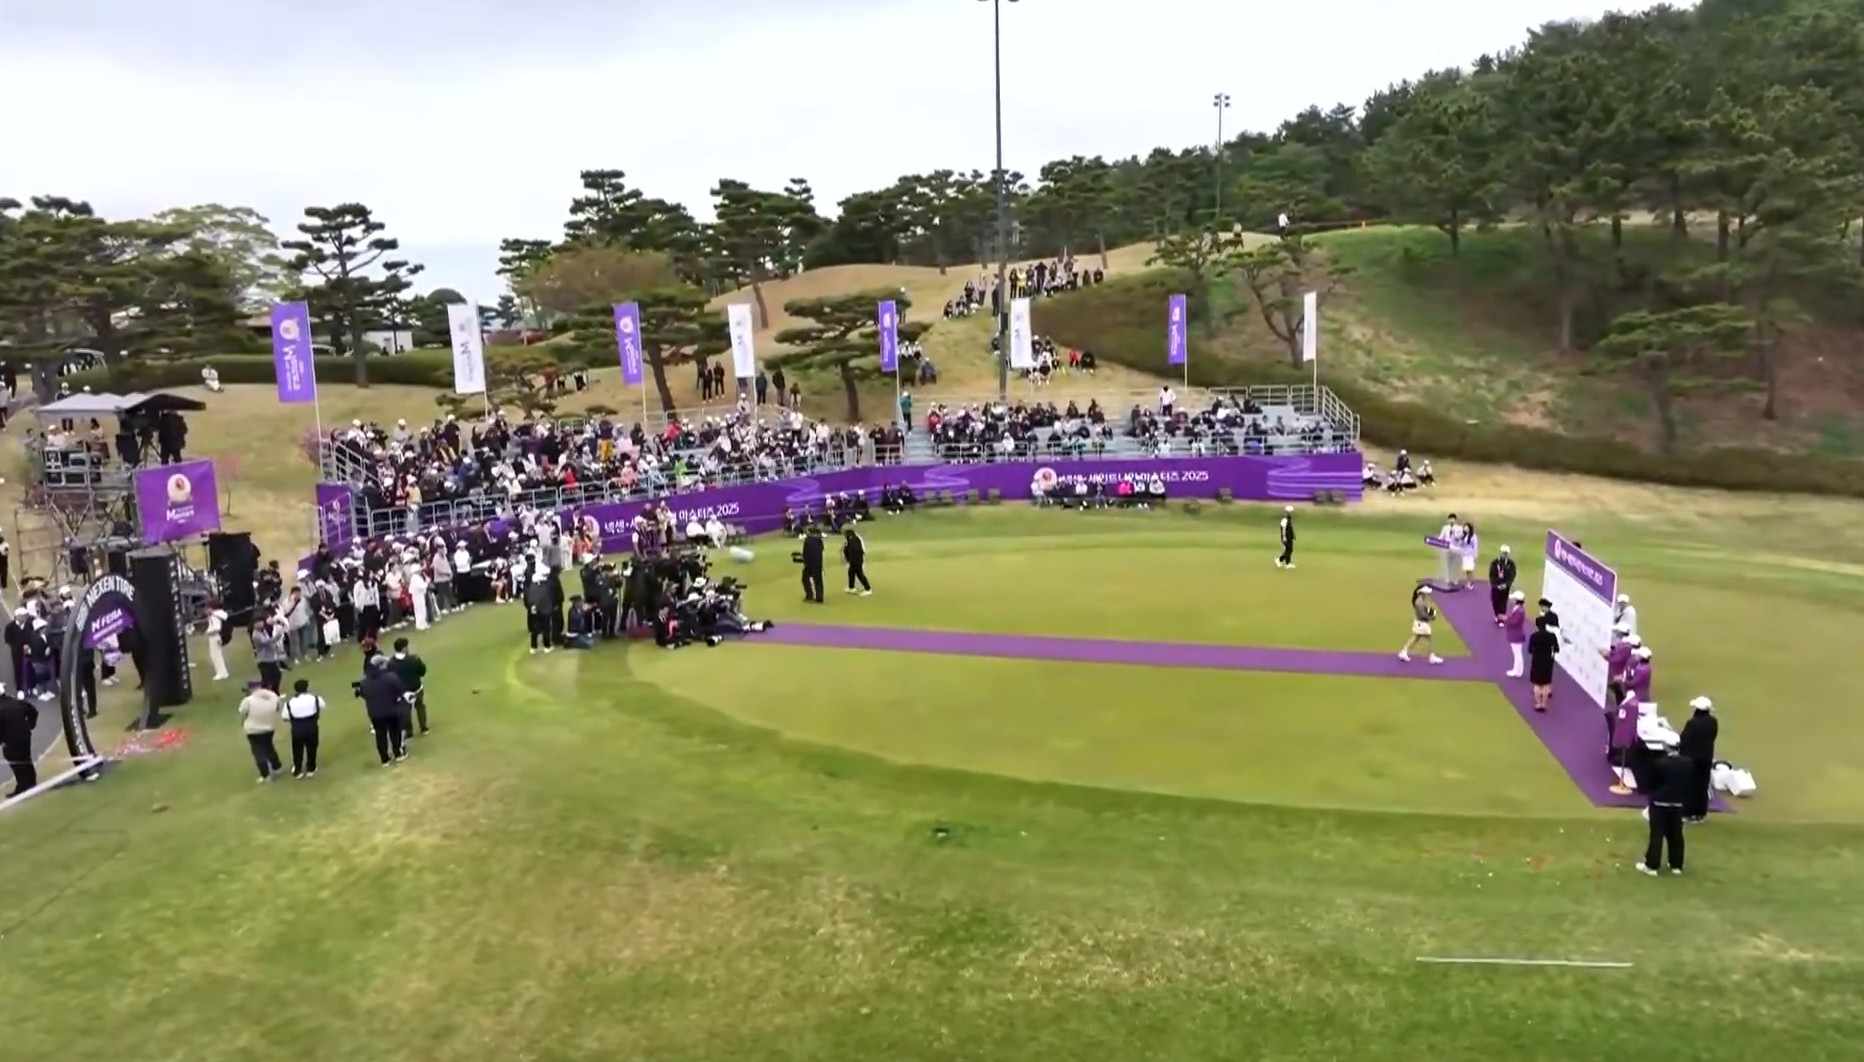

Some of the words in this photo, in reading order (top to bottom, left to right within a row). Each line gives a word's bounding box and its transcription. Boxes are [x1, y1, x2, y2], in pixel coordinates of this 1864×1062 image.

[1181, 470, 1209, 482] 2025
[716, 502, 740, 517] 2025
[86, 576, 115, 608] NEXEN
[115, 575, 135, 601] TIRE
